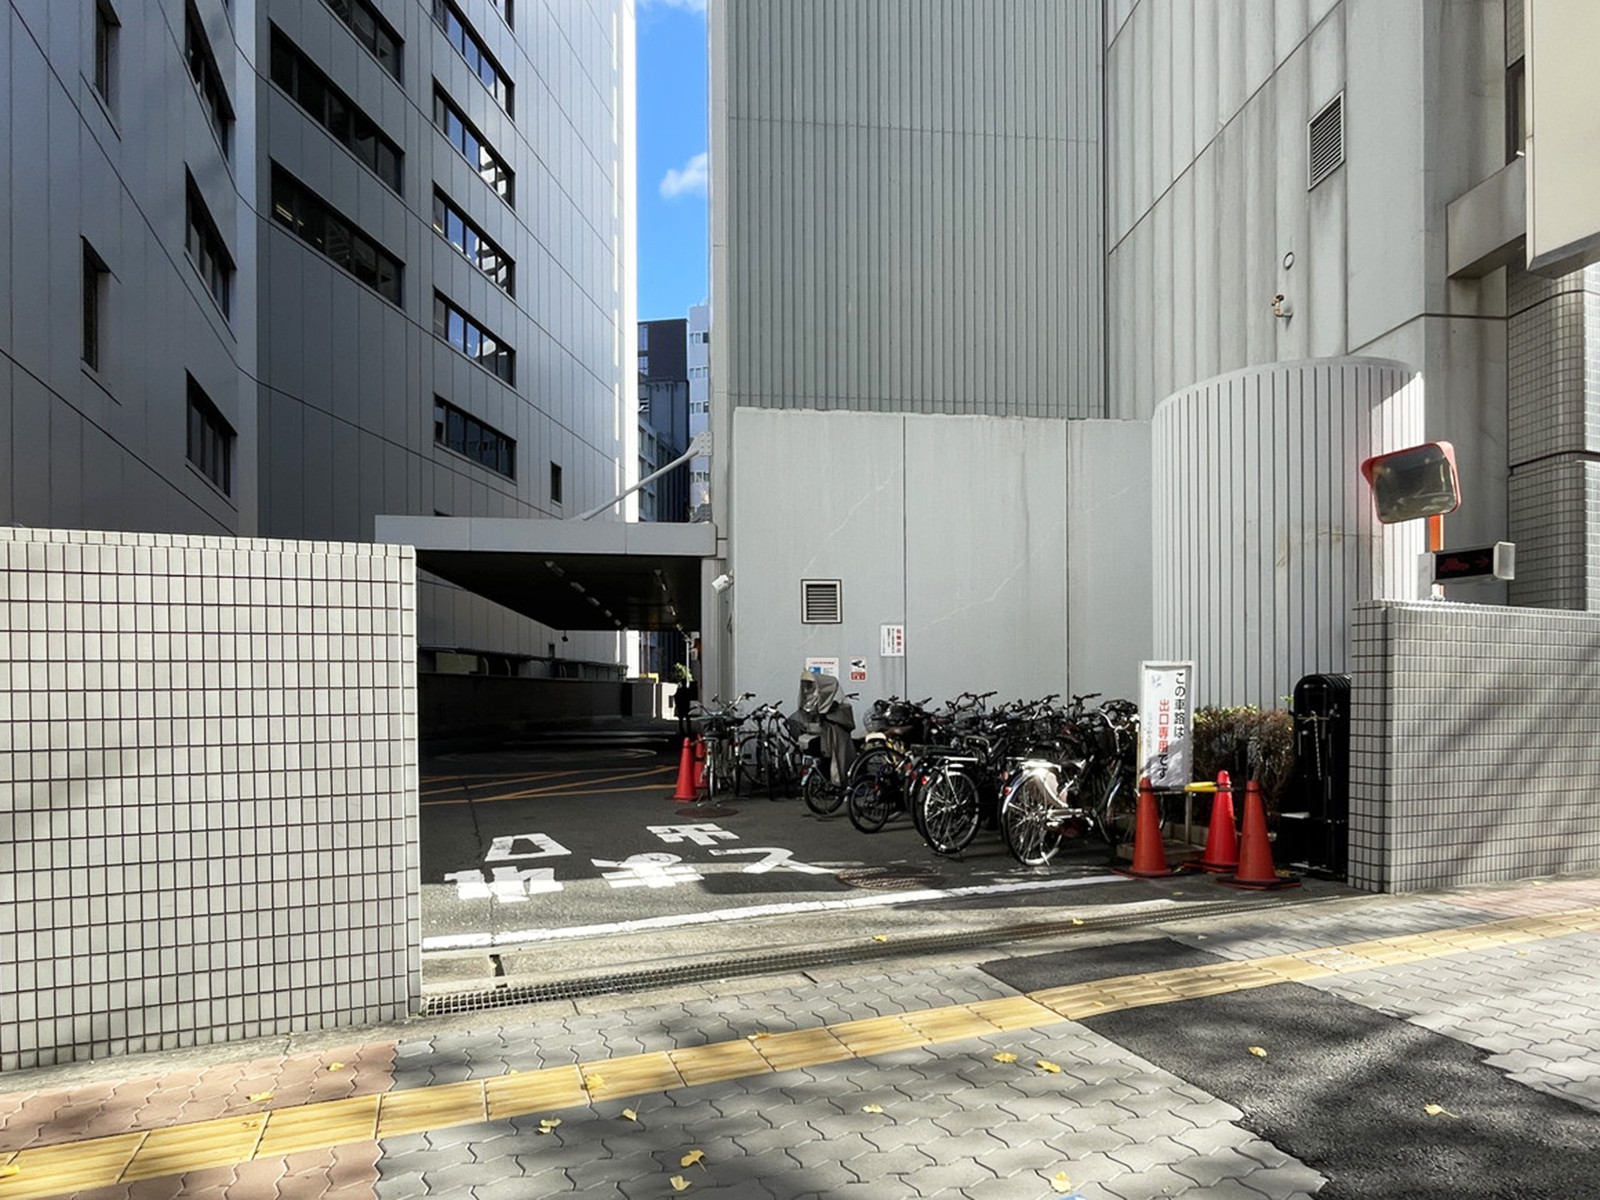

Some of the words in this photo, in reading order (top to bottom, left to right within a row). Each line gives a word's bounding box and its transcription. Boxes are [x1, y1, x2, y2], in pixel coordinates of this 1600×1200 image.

[1158, 699, 1170, 780] 出口専用です
[1174, 672, 1186, 739] この車路は
